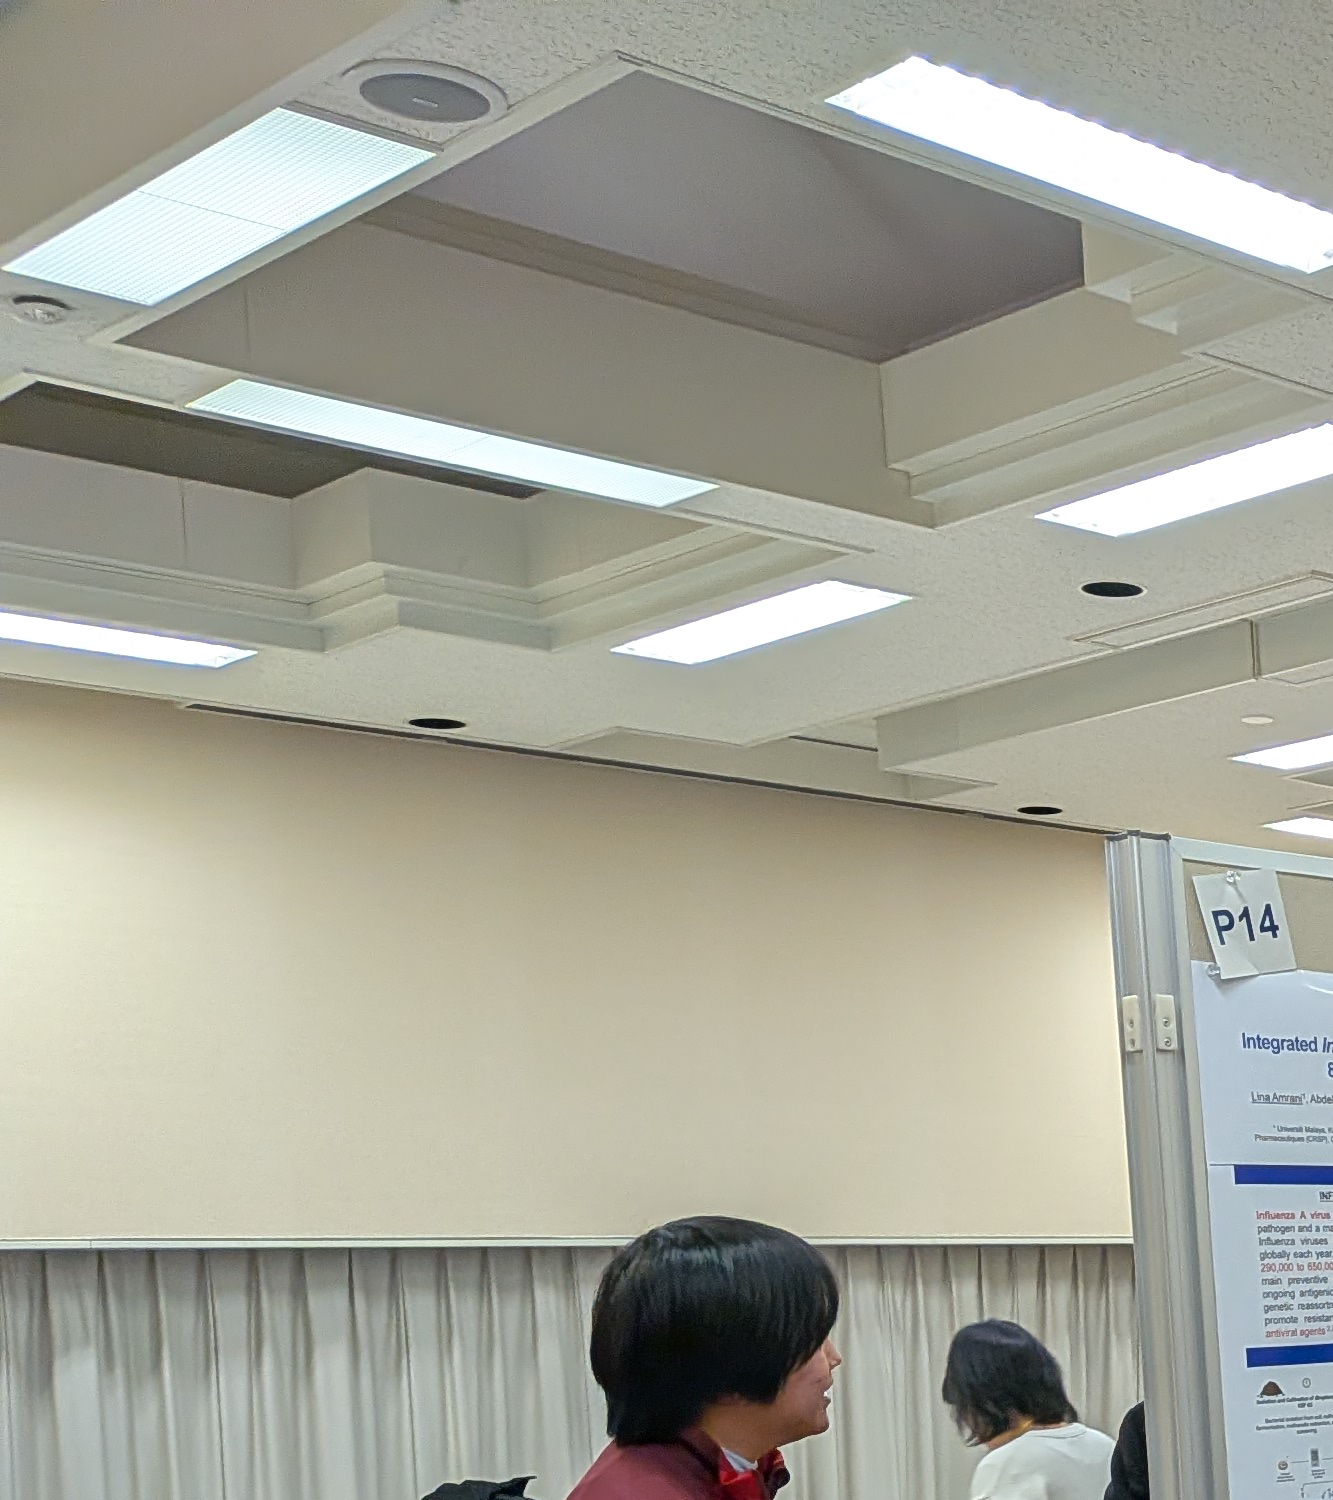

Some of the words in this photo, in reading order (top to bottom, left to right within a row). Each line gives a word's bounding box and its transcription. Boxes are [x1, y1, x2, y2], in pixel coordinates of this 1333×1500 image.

[1212, 903, 1279, 945] P14
[1241, 1032, 1317, 1054] Integrated
[1252, 1091, 1270, 1103] Lina
[1256, 1210, 1295, 1220] Influenza
[1300, 1211, 1306, 1219] A
[1310, 1211, 1330, 1219] virus
[1258, 1224, 1295, 1234] pathogen
[1298, 1224, 1312, 1232] and
[1259, 1237, 1295, 1245] Influenza
[1300, 1237, 1328, 1245] viruses
[1260, 1250, 1290, 1262] globally
[1293, 1250, 1313, 1259] each
[1261, 1263, 1293, 1273] 290,000
[1297, 1263, 1304, 1271] to
